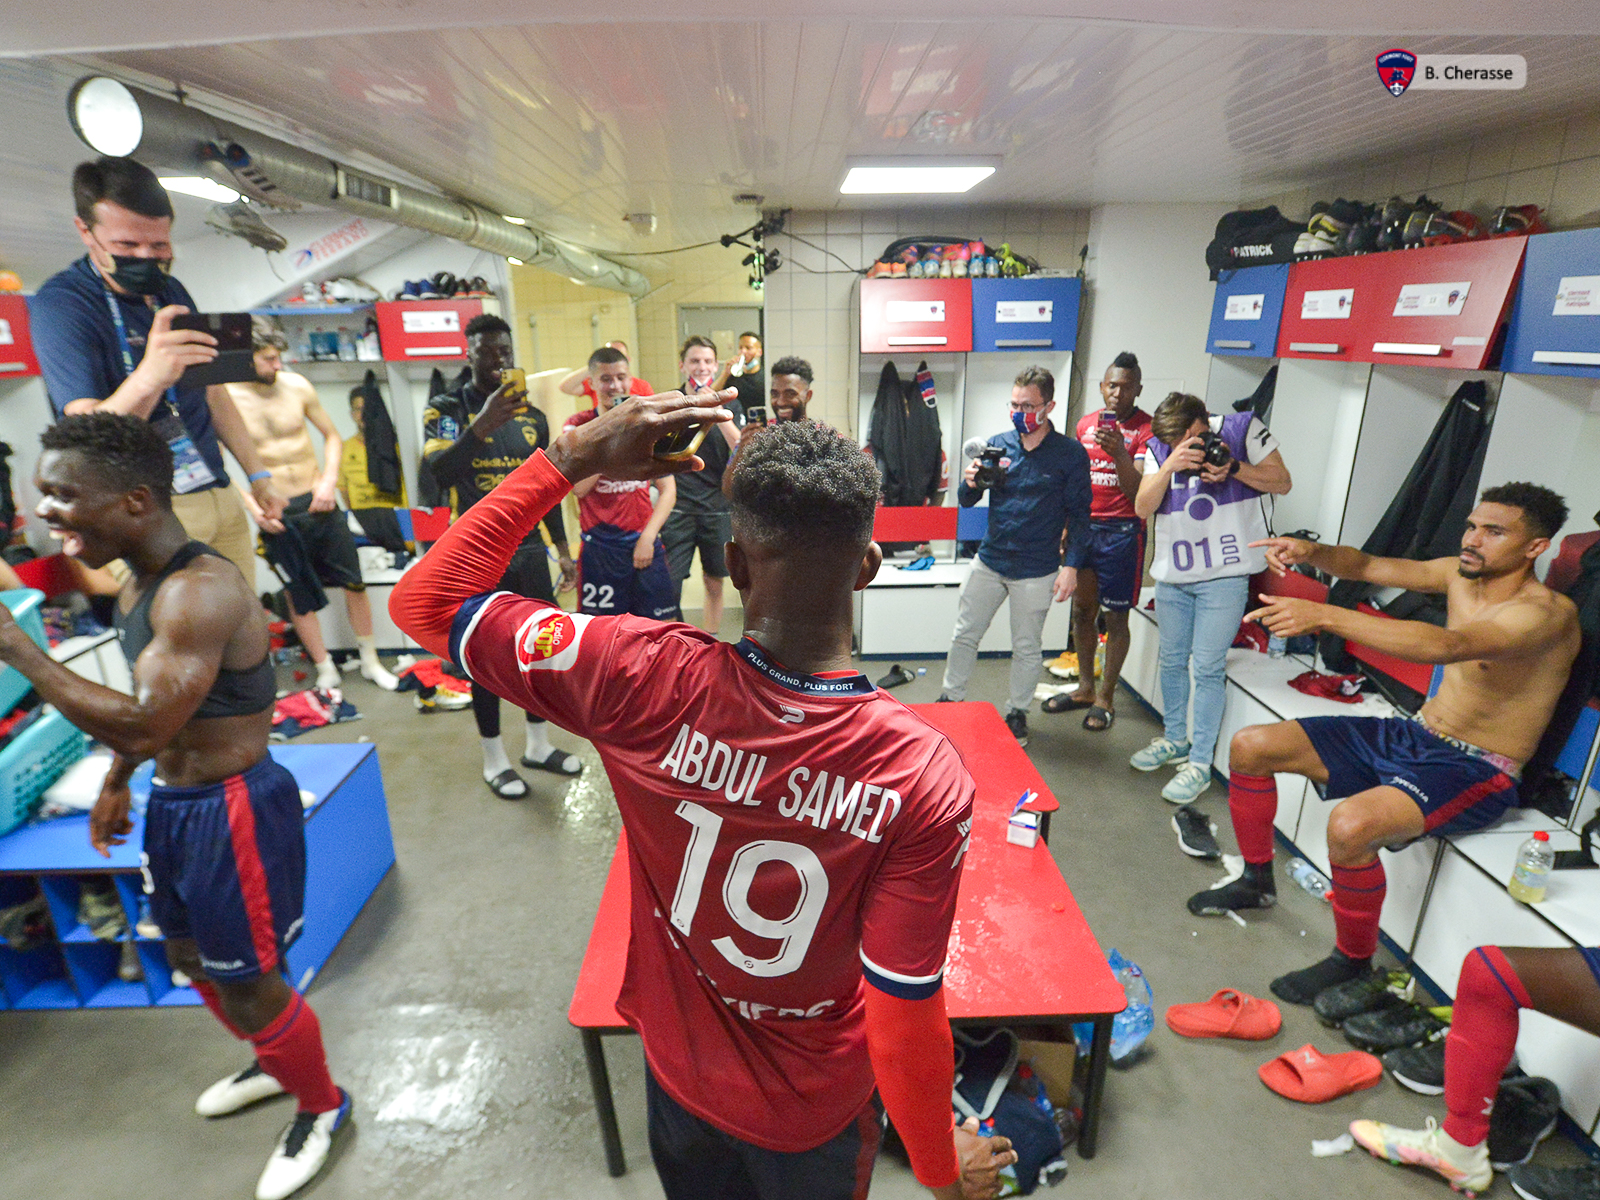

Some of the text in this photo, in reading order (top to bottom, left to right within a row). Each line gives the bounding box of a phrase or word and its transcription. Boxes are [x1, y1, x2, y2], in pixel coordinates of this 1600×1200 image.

[1233, 243, 1274, 257] PATRICK
[1172, 537, 1212, 571] 01
[582, 582, 615, 608] 22
[552, 622, 563, 646] radio
[747, 652, 854, 691] PLUS GRAND, PLUS FORT
[659, 723, 902, 843] ABDUL SAMED
[670, 800, 829, 977] 19
